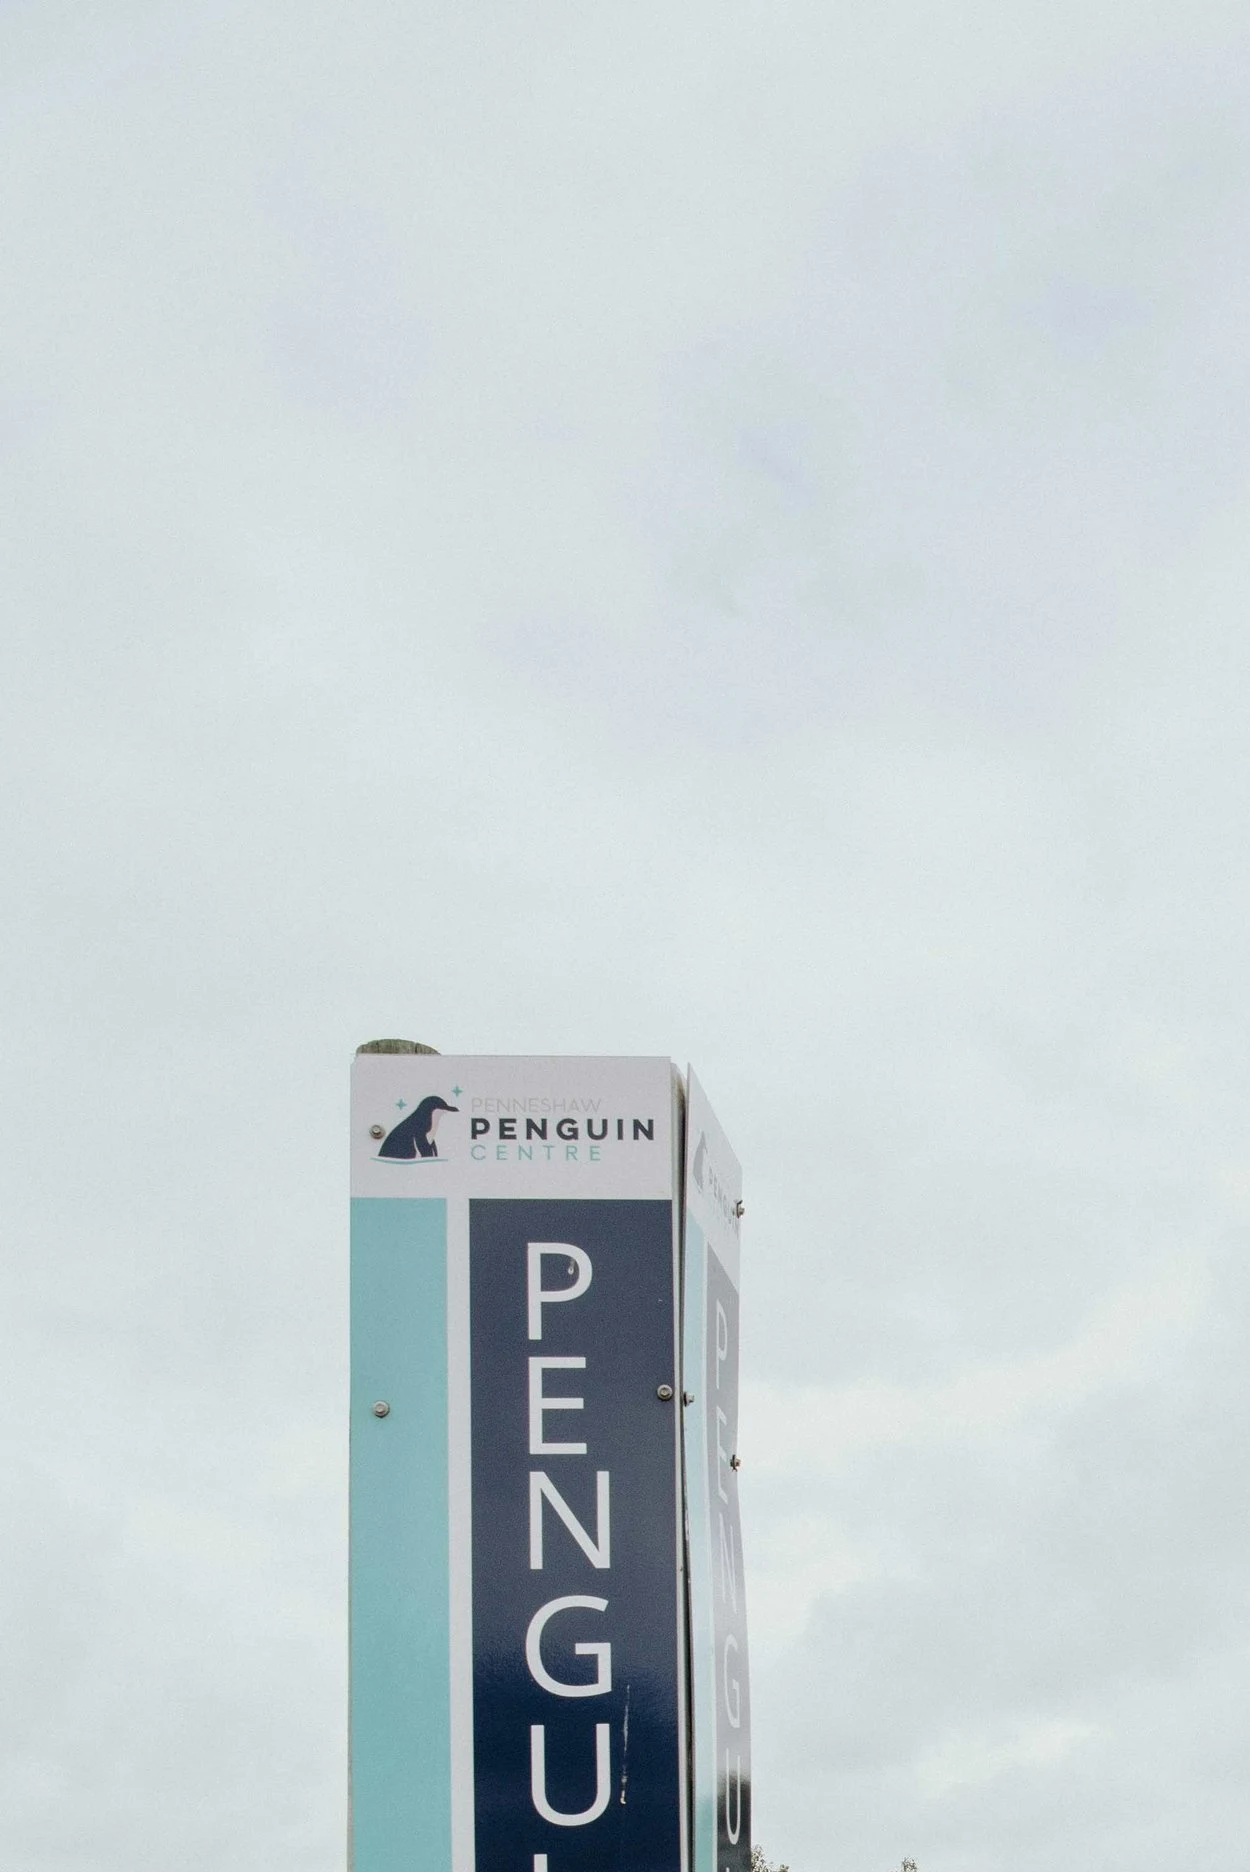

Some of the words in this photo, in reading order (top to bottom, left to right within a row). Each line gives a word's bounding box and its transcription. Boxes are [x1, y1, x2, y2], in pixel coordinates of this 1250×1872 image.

[471, 1097, 602, 1113] PENNESHAW
[470, 1117, 655, 1141] PENGUIN
[470, 1144, 602, 1162] CENTRE
